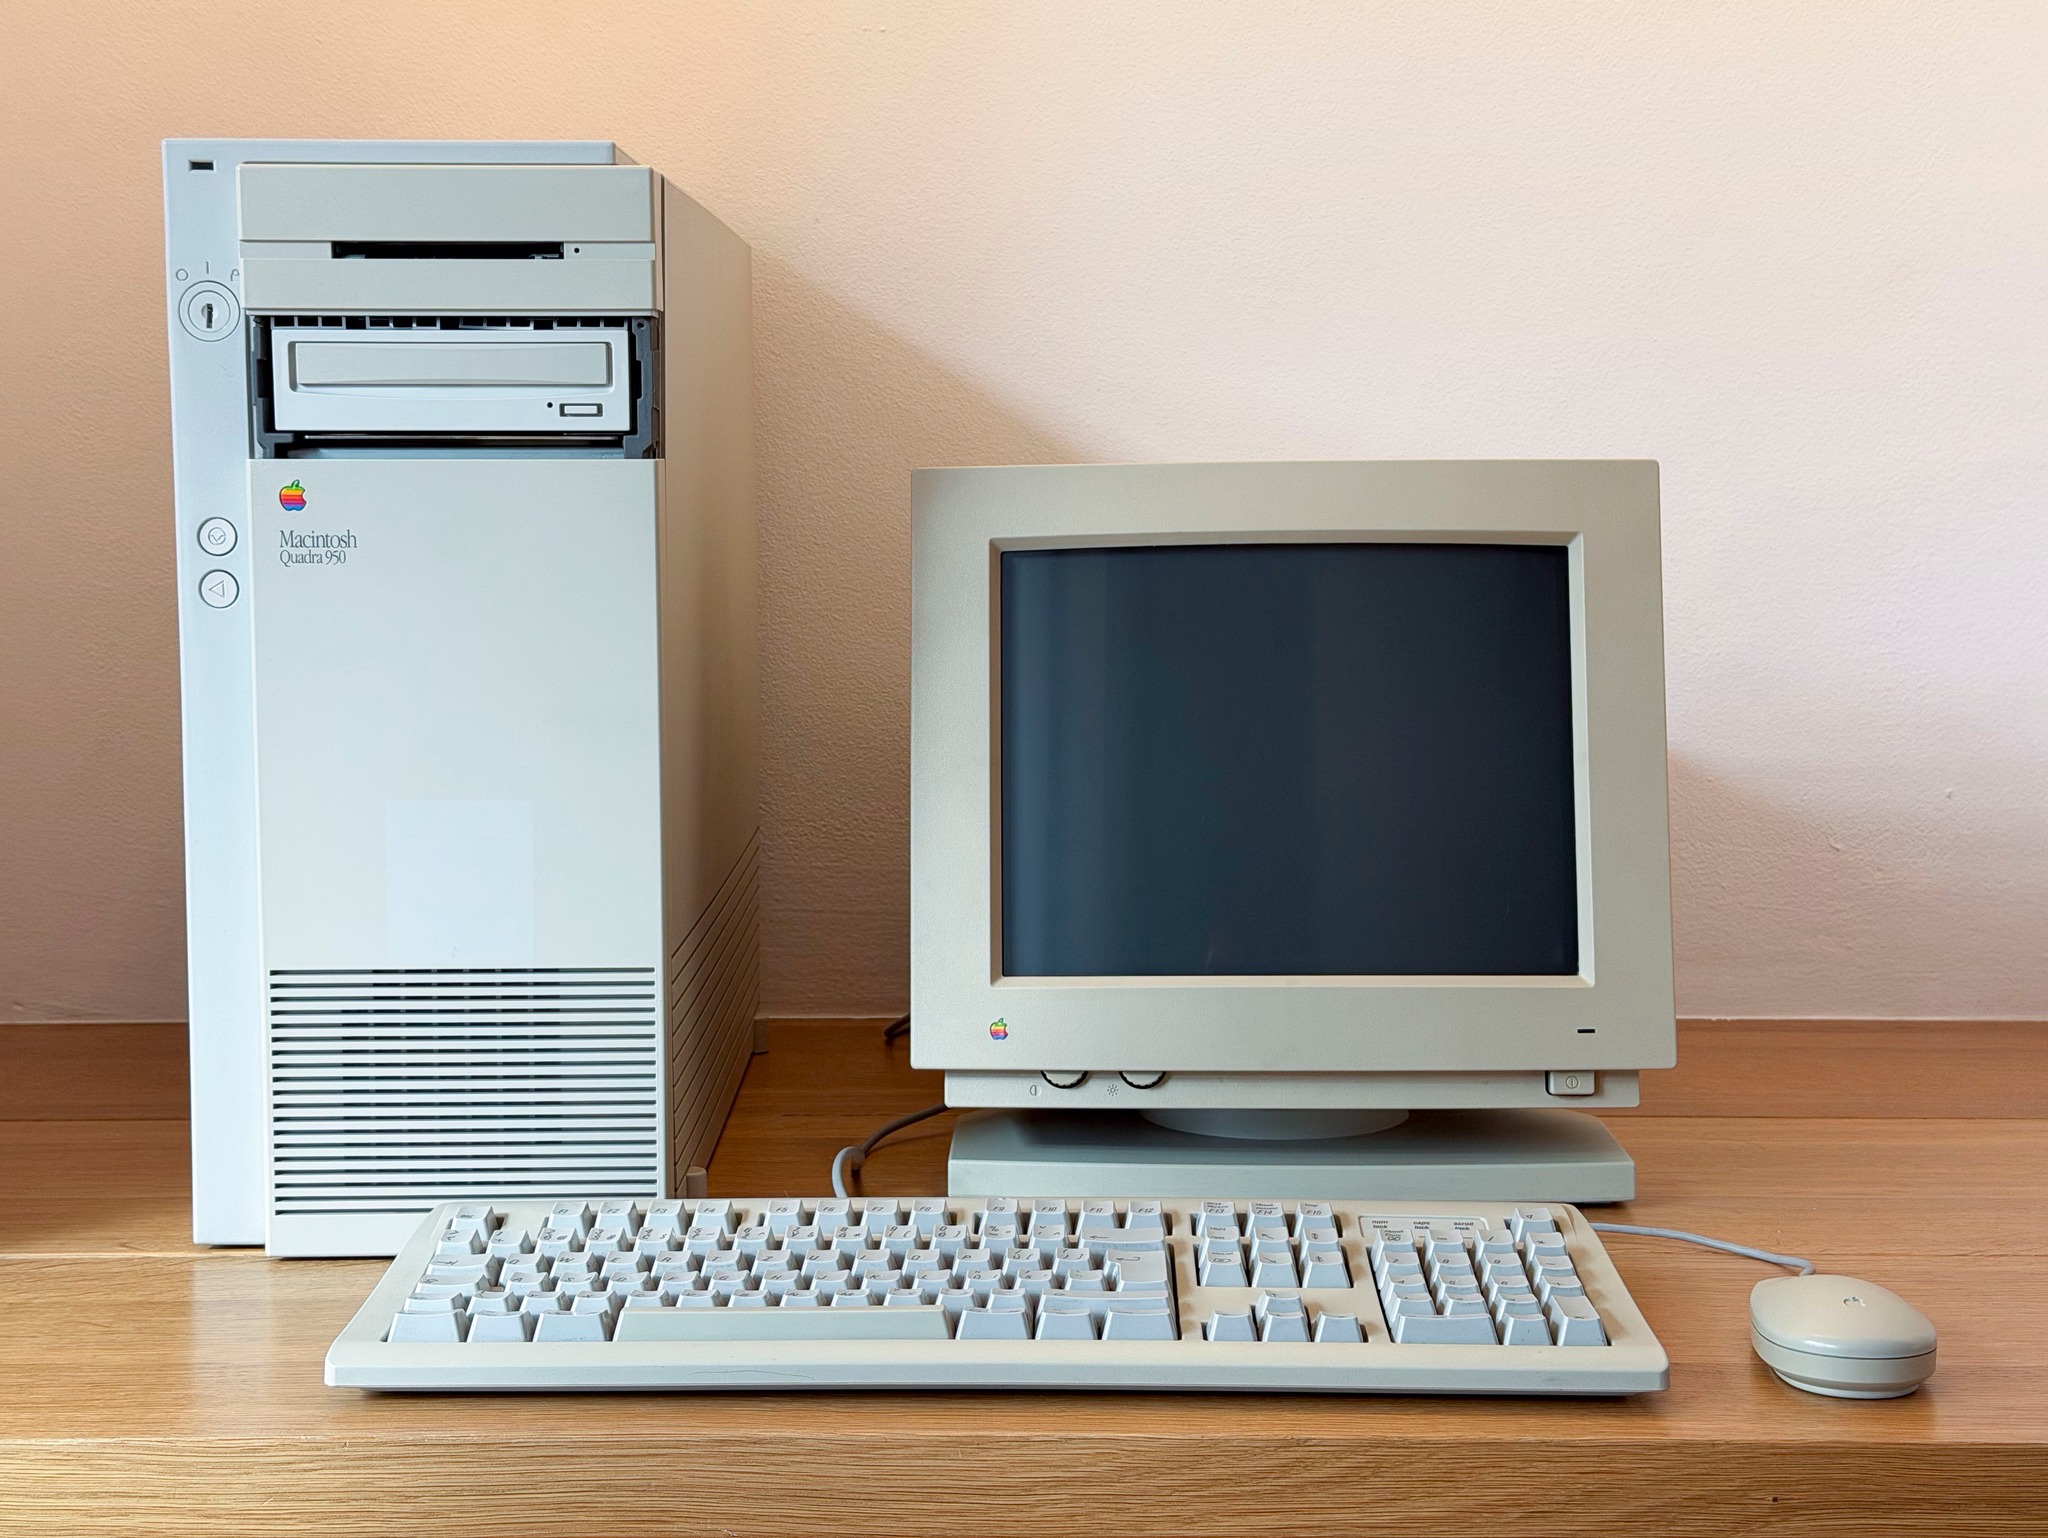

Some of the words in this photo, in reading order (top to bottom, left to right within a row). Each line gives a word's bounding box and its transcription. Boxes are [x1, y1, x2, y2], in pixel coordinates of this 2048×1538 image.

[279, 529, 358, 548] Macintosh
[280, 550, 324, 568] Quadra
[325, 550, 347, 566] 950
